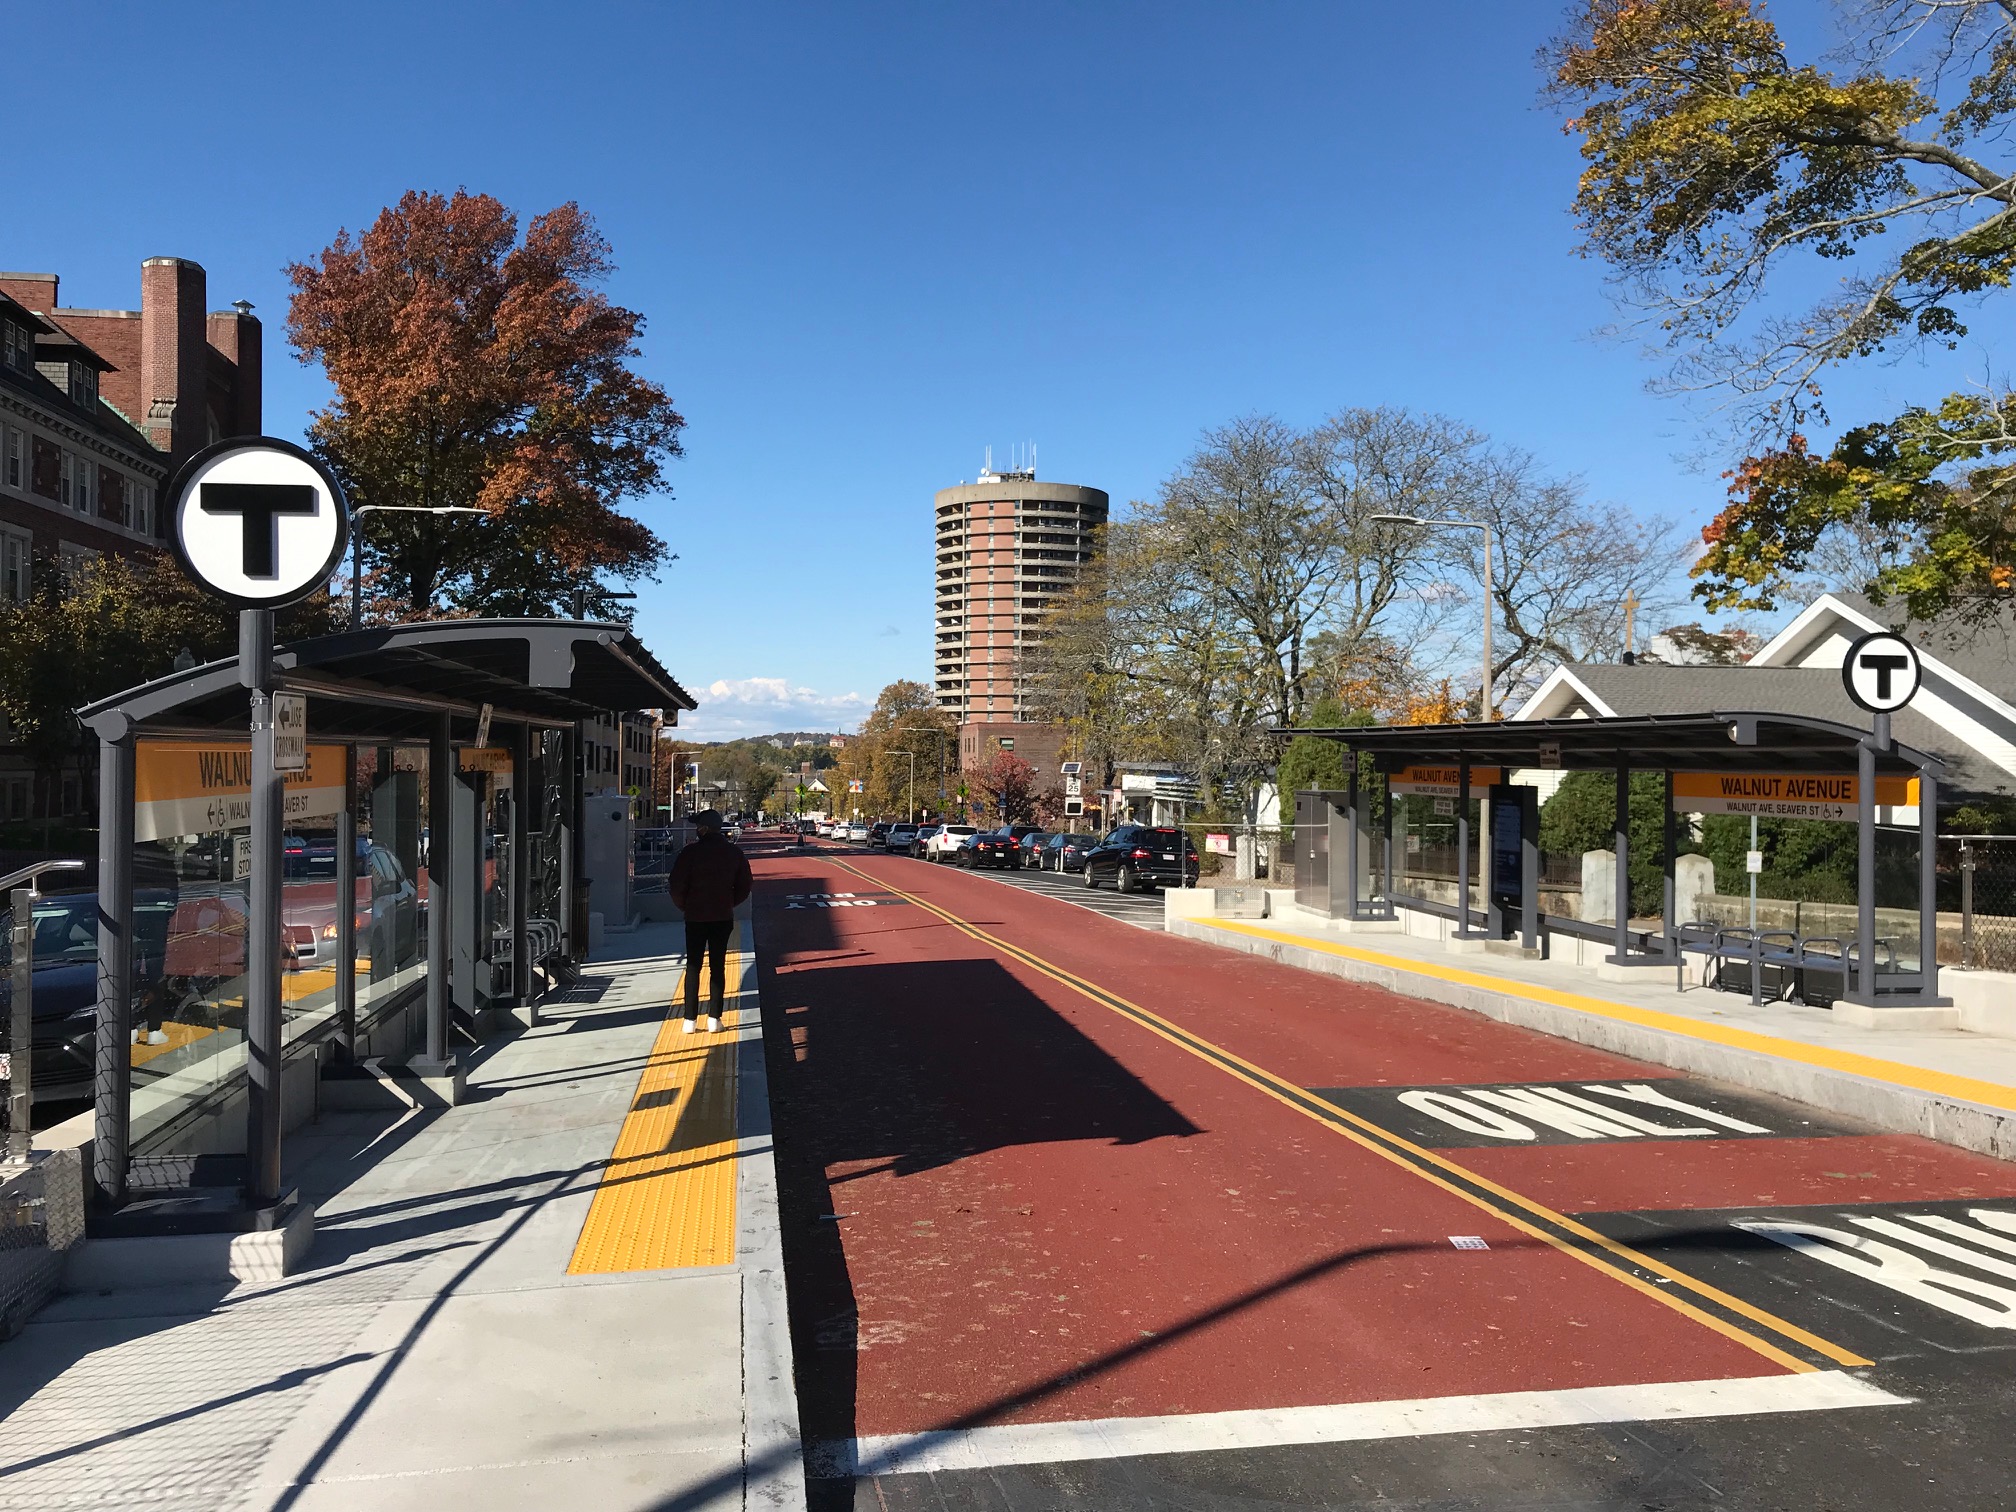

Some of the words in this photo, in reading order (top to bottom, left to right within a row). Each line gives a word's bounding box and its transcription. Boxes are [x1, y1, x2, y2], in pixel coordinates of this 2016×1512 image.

[200, 483, 316, 578] T
[1860, 654, 1908, 700] T
[289, 706, 302, 728] USE
[276, 736, 303, 758] CROSSWALK
[199, 751, 251, 788] WALNU
[1412, 769, 1441, 782] WALNUT
[1068, 784, 1079, 792] 25
[1721, 777, 1782, 797] WALNUT
[1786, 779, 1852, 799] AVENUE
[229, 801, 251, 820] WALN
[301, 796, 308, 812] ST
[1726, 802, 1756, 812] WALNUT
[1758, 803, 1774, 814] AVE,
[1776, 804, 1807, 815] SEAVER
[1809, 805, 1819, 816] ST
[240, 841, 251, 856] FIRS
[238, 859, 251, 875] STO
[784, 900, 878, 910] ONLY
[1397, 1084, 1776, 1141] ONLY
